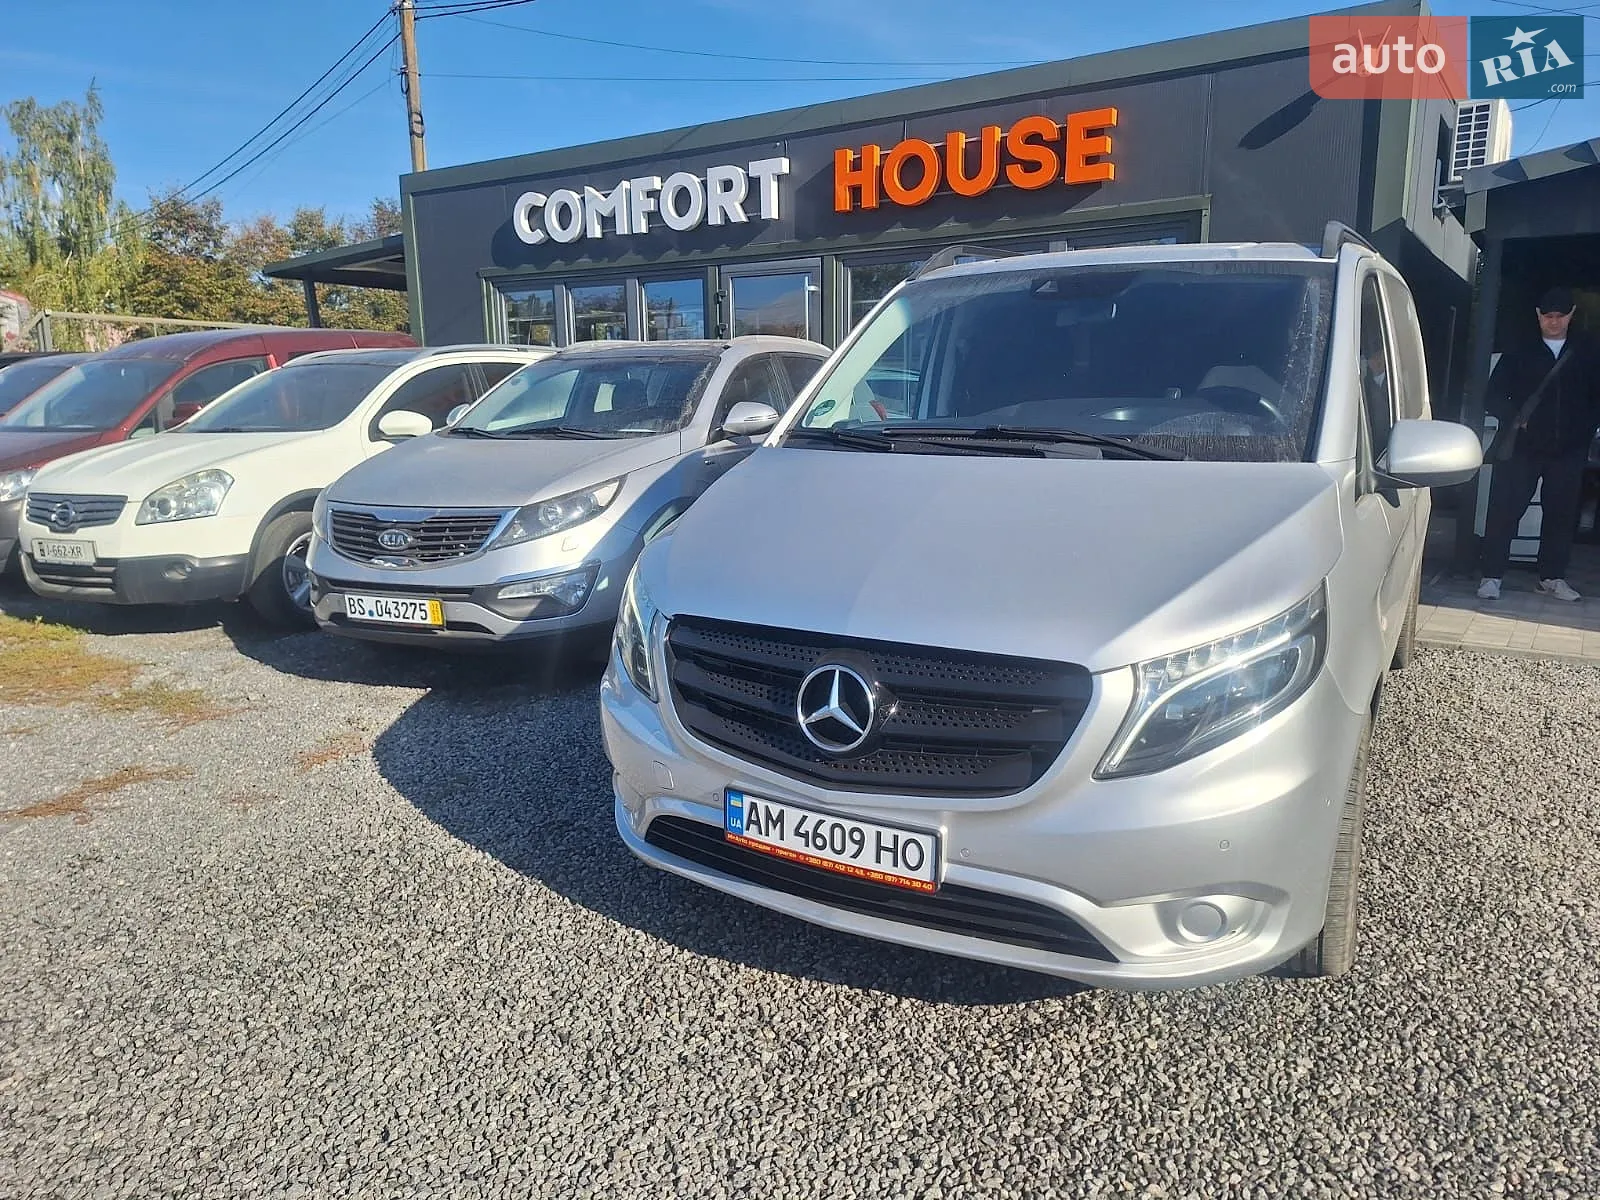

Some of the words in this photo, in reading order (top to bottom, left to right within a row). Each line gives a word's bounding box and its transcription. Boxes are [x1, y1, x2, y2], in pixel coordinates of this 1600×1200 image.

[513, 157, 790, 245] COMFORT
[834, 107, 1118, 213] HOUSE
[383, 534, 405, 545] KIA
[347, 597, 366, 616] BS
[375, 599, 428, 621] 043275
[730, 817, 742, 829] UA
[745, 801, 785, 841] AM
[793, 814, 866, 859] 4609
[875, 830, 925, 872] HO
[899, 877, 911, 886] 714
